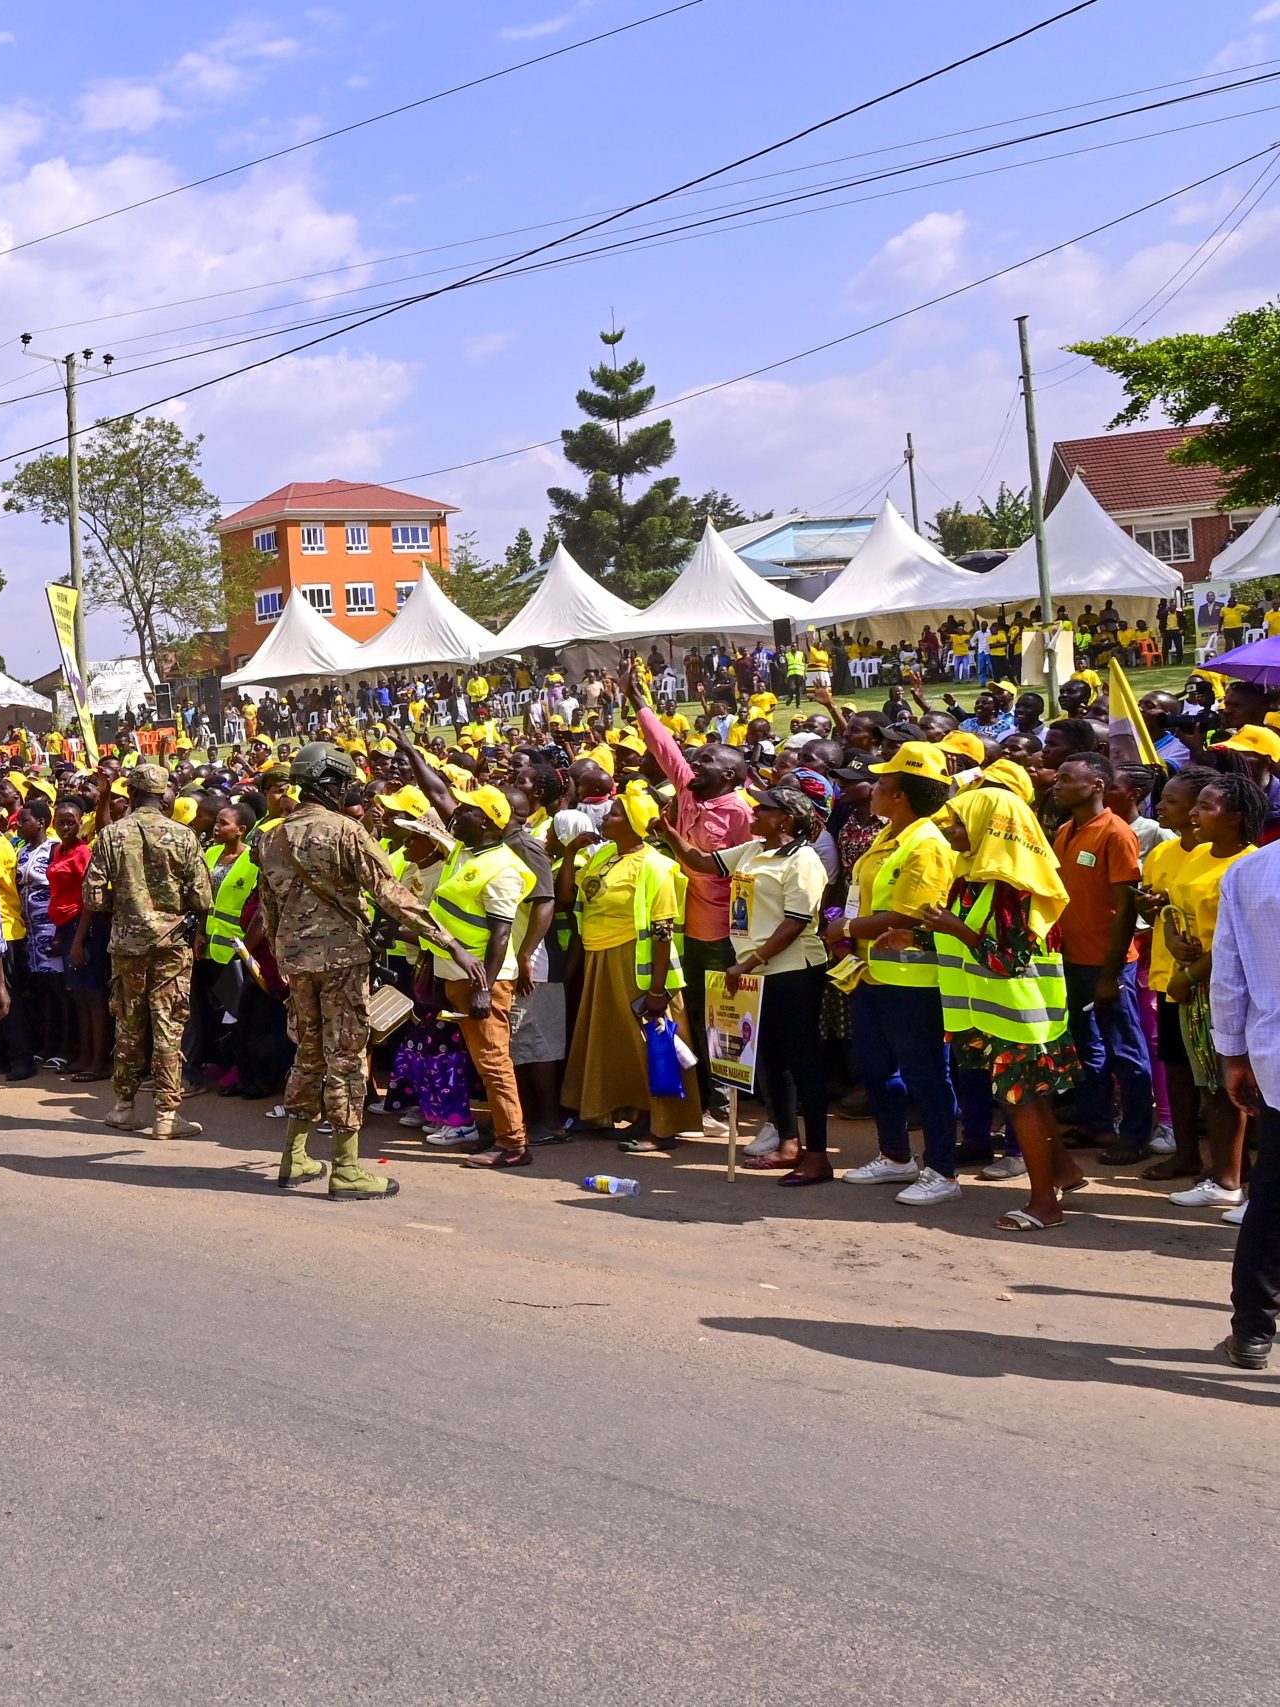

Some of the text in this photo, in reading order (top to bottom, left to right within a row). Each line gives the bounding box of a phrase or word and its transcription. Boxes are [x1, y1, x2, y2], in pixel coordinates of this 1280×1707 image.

[905, 760, 923, 769] NRM
[411, 804, 424, 814] NRM
[490, 804, 502, 818] NRM
